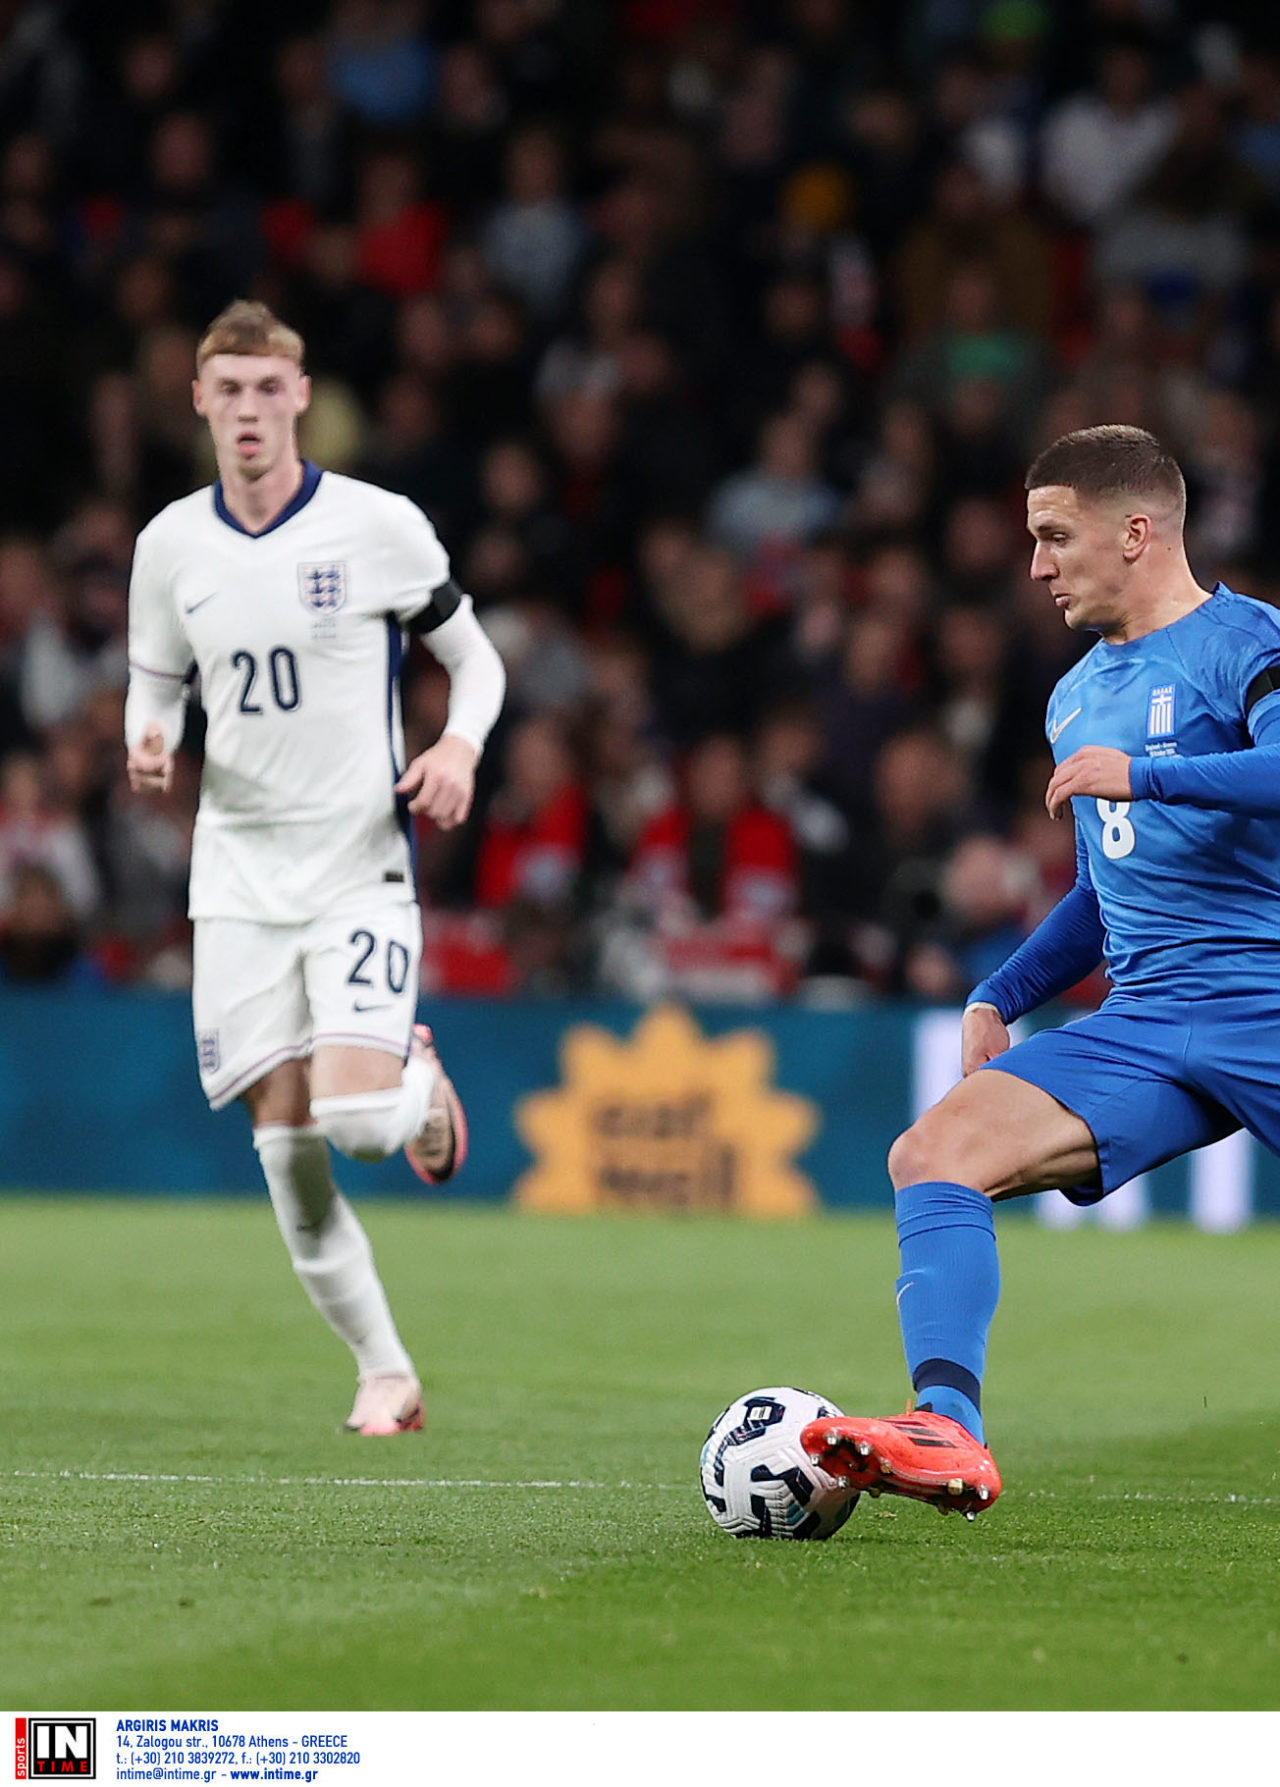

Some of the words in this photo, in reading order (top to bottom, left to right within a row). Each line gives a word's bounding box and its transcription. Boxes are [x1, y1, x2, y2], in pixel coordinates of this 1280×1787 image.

[232, 646, 301, 714] 20
[1096, 798, 1136, 860] 8
[347, 928, 410, 993] 20
